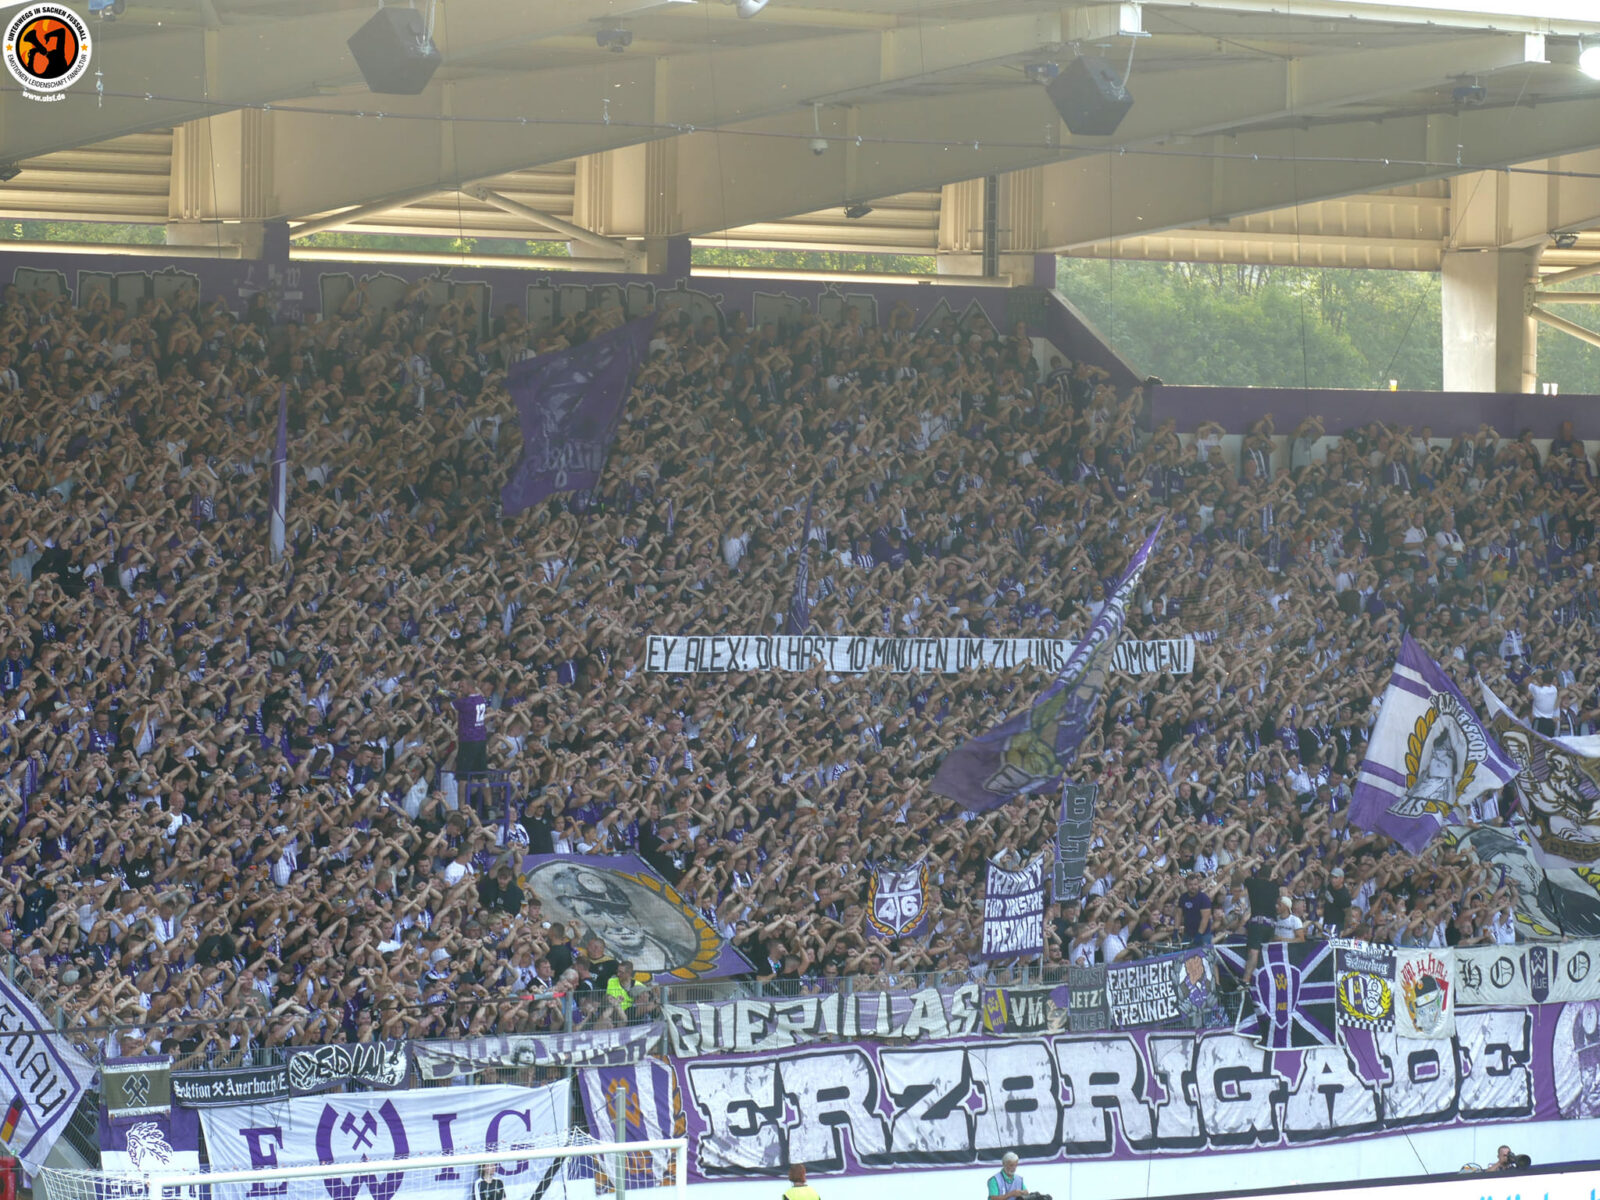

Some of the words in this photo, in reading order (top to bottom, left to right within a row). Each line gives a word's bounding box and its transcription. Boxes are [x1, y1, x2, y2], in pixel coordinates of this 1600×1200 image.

[648, 636, 677, 671] EY
[684, 637, 749, 671] ALEX!
[755, 637, 780, 670] DU
[788, 637, 838, 670] HAST
[846, 637, 867, 670] 10
[872, 638, 948, 672] MINUTEN
[956, 639, 984, 671] UM
[981, 913, 1044, 955] FREUNDE
[1107, 960, 1173, 990] FREIHEIT
[1131, 981, 1176, 1003] UNSERE
[1111, 996, 1180, 1027] FREUNDE
[688, 1008, 1532, 1176] ERZBRIGADE
